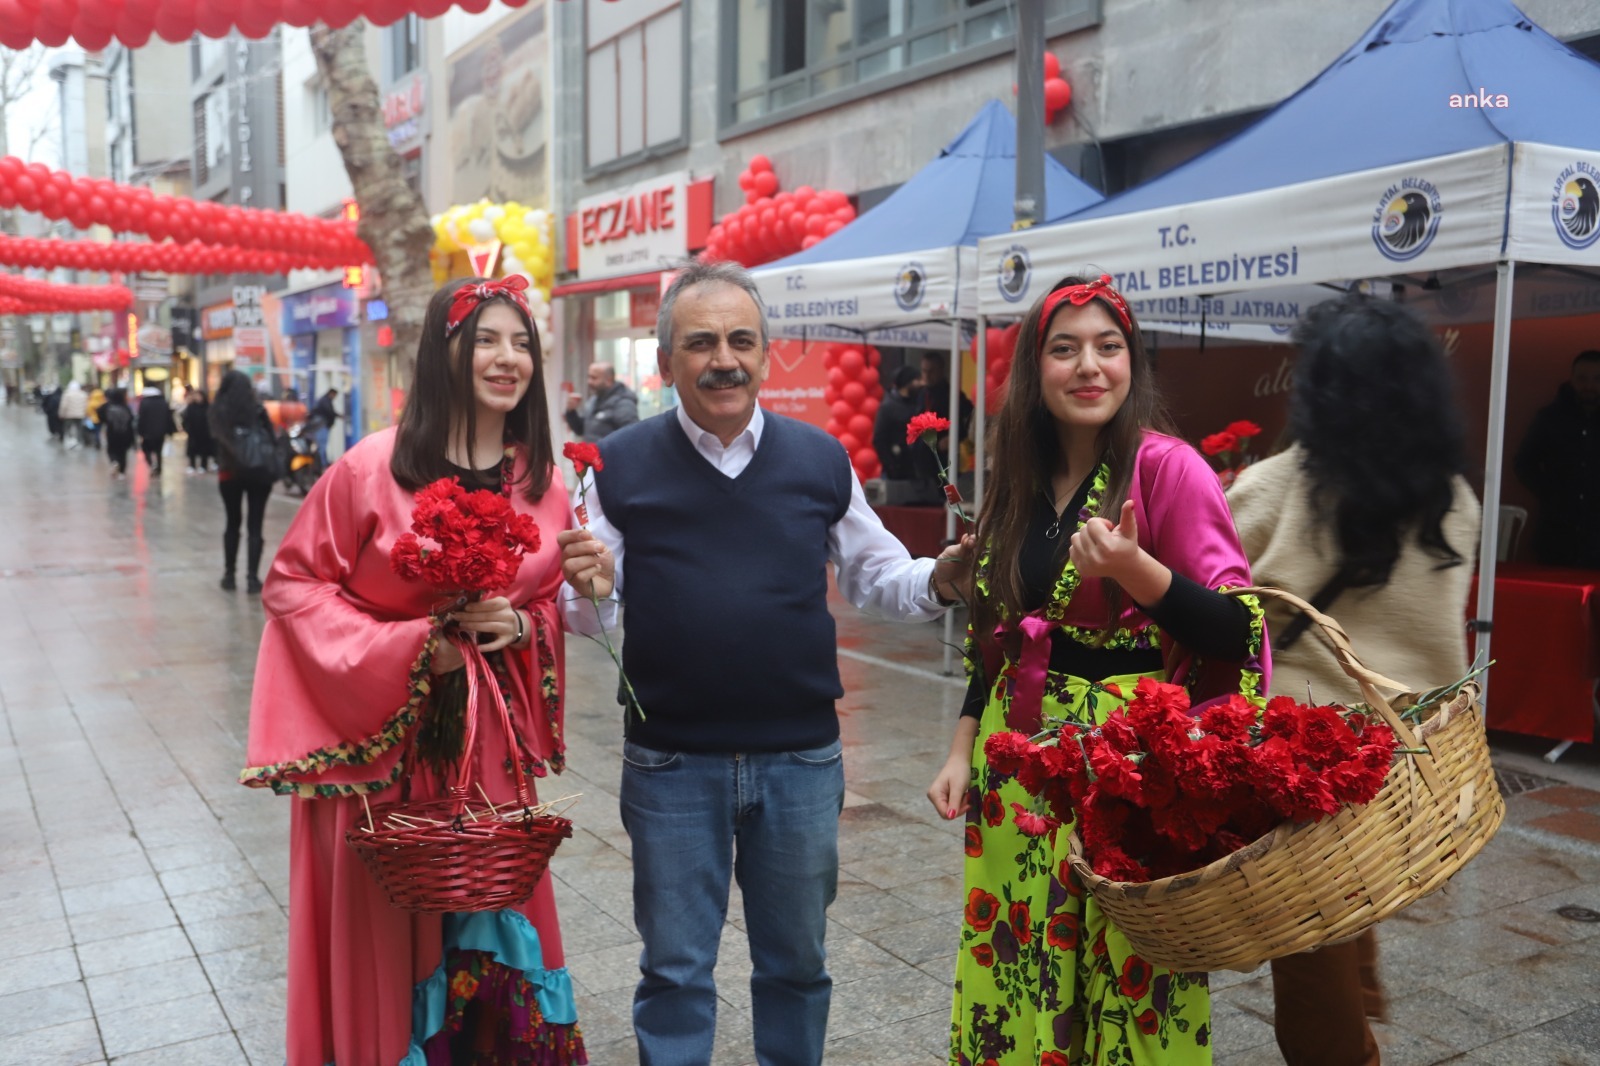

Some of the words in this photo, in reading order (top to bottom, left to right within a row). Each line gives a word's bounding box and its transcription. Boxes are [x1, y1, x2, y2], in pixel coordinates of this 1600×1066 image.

[582, 185, 674, 247] ECZANE
[1373, 184, 1400, 223] KARTAL
[1158, 224, 1197, 248] T.C.
[785, 275, 807, 291] T.C.
[1113, 270, 1152, 293] TAL
[1158, 246, 1298, 289] BELEDİYESİ
[784, 296, 859, 319] BELEDİYESİ
